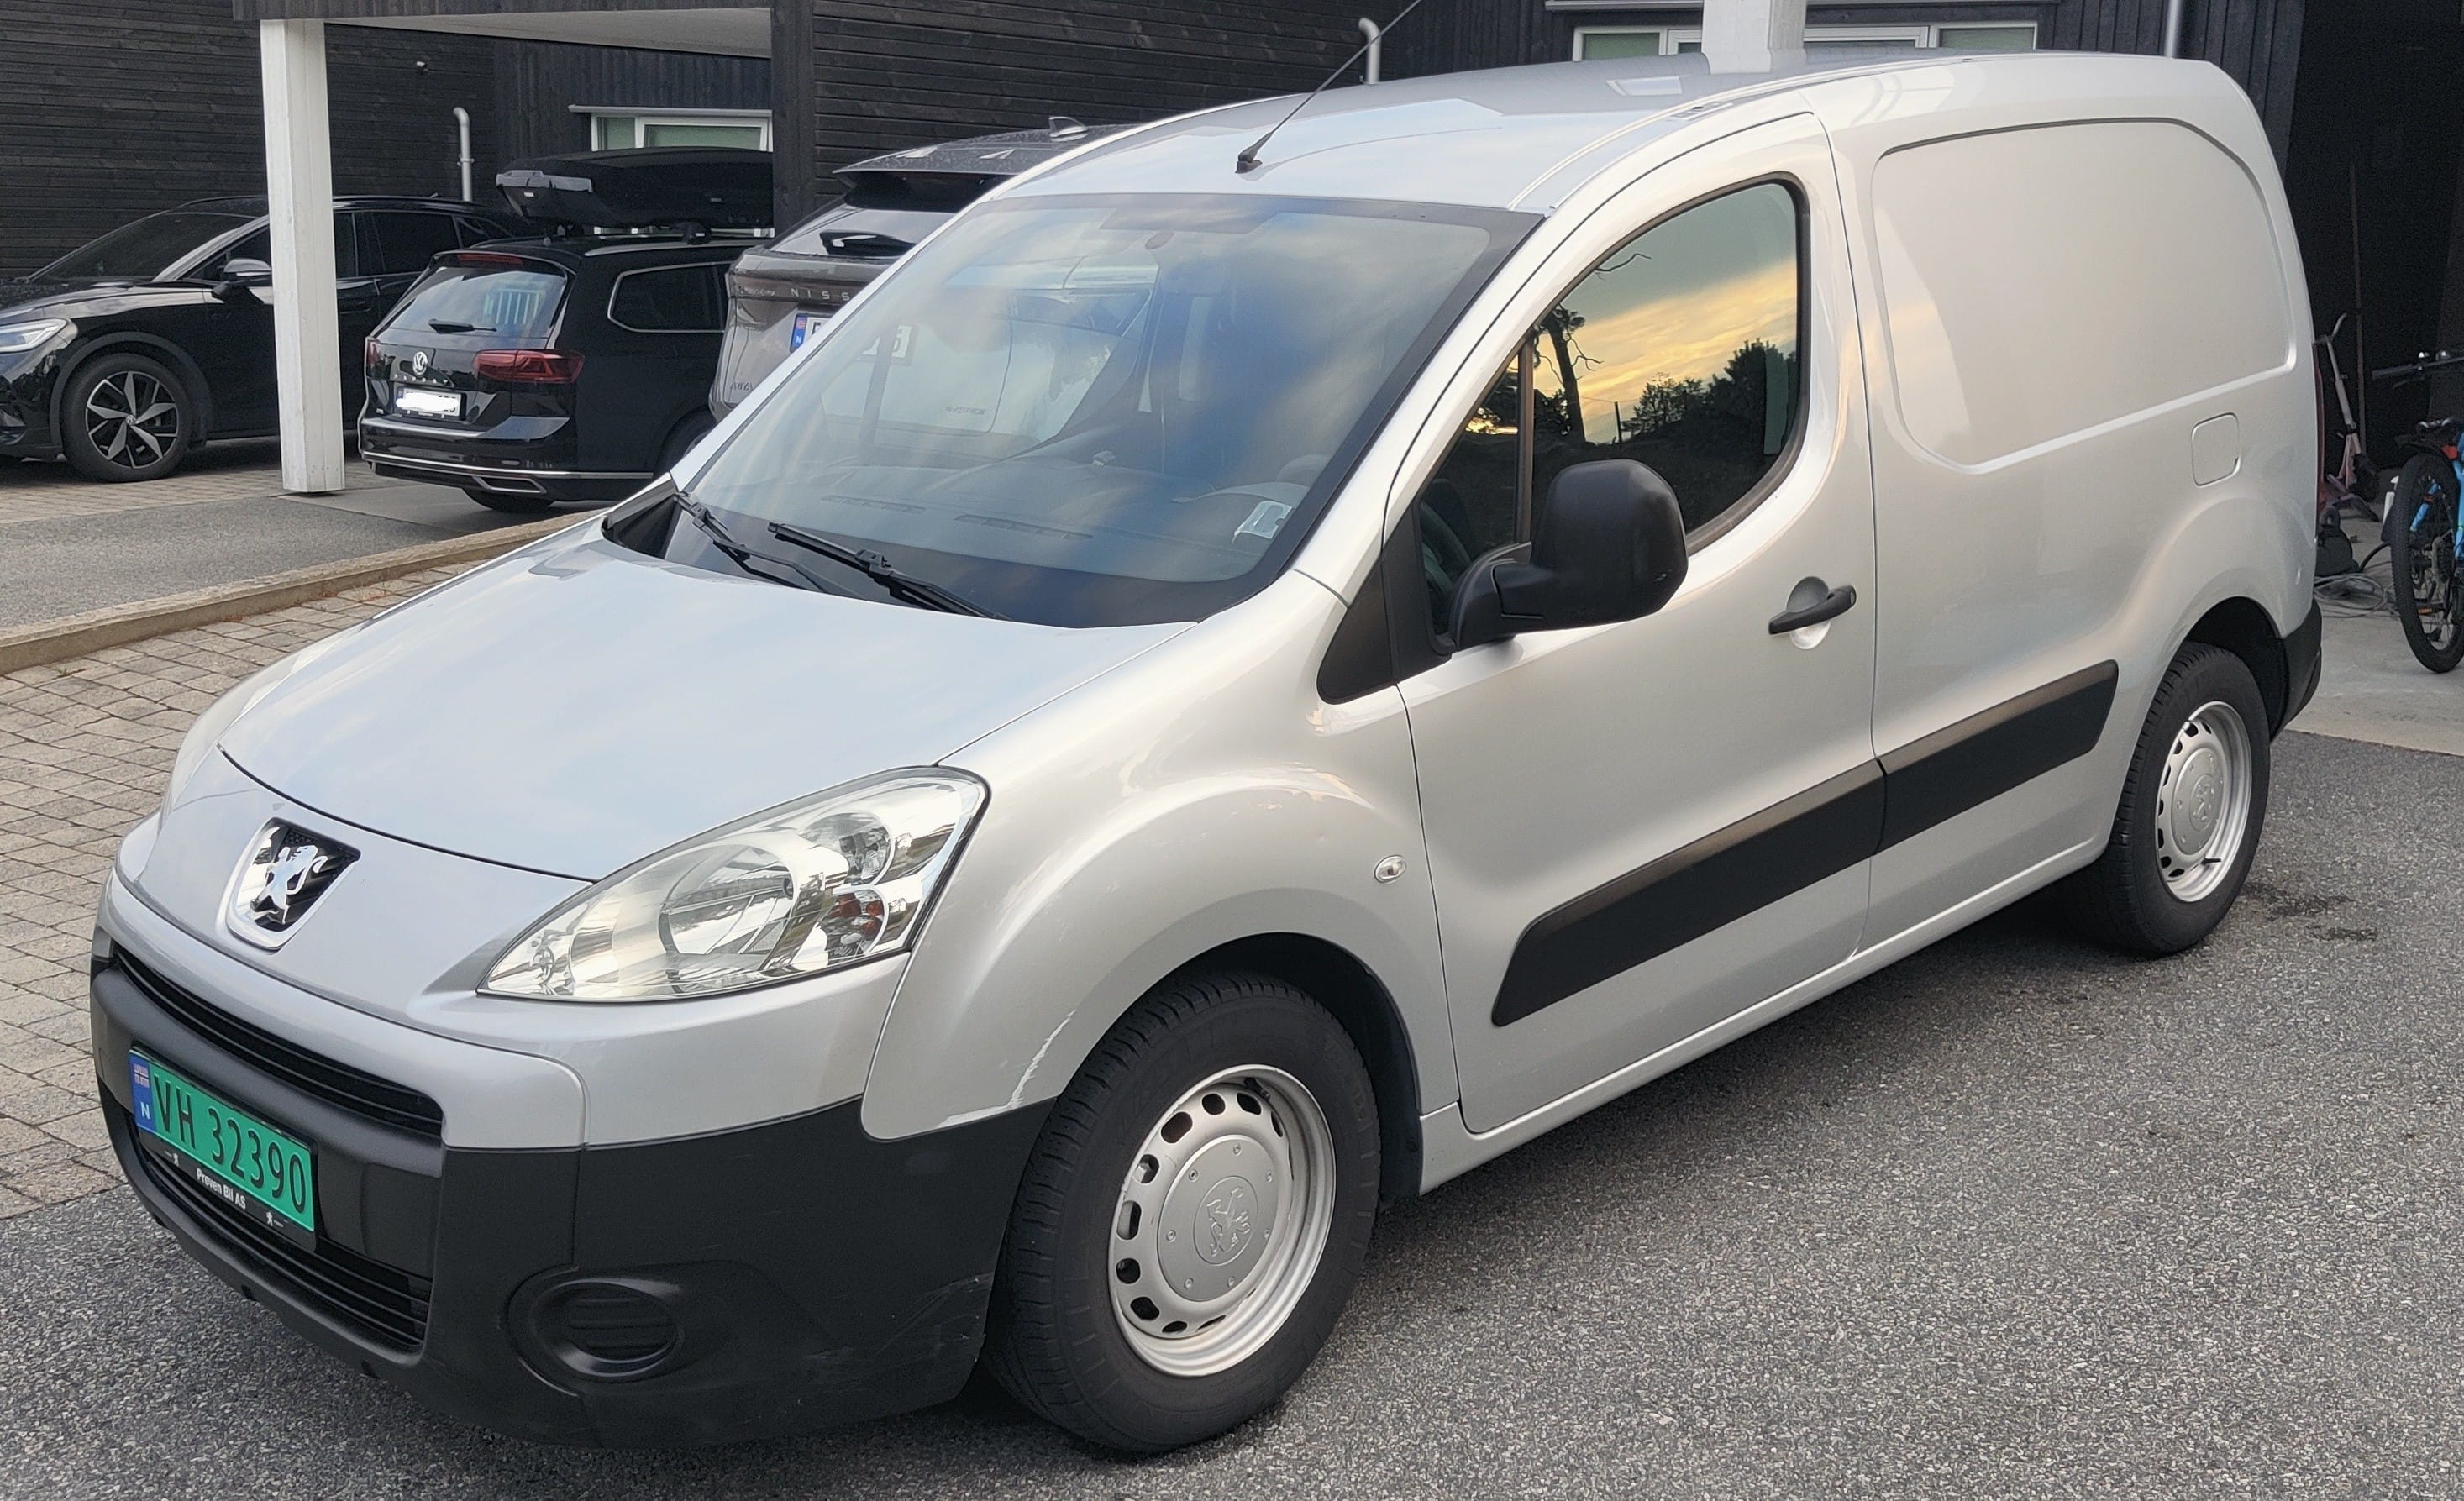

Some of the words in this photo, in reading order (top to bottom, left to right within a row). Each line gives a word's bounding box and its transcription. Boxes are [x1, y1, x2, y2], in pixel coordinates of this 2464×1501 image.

[791, 288, 850, 301] NISS
[140, 1101, 150, 1120] N
[154, 1073, 196, 1150] VH
[208, 1106, 307, 1214] 32390
[235, 1193, 246, 1210] AS
